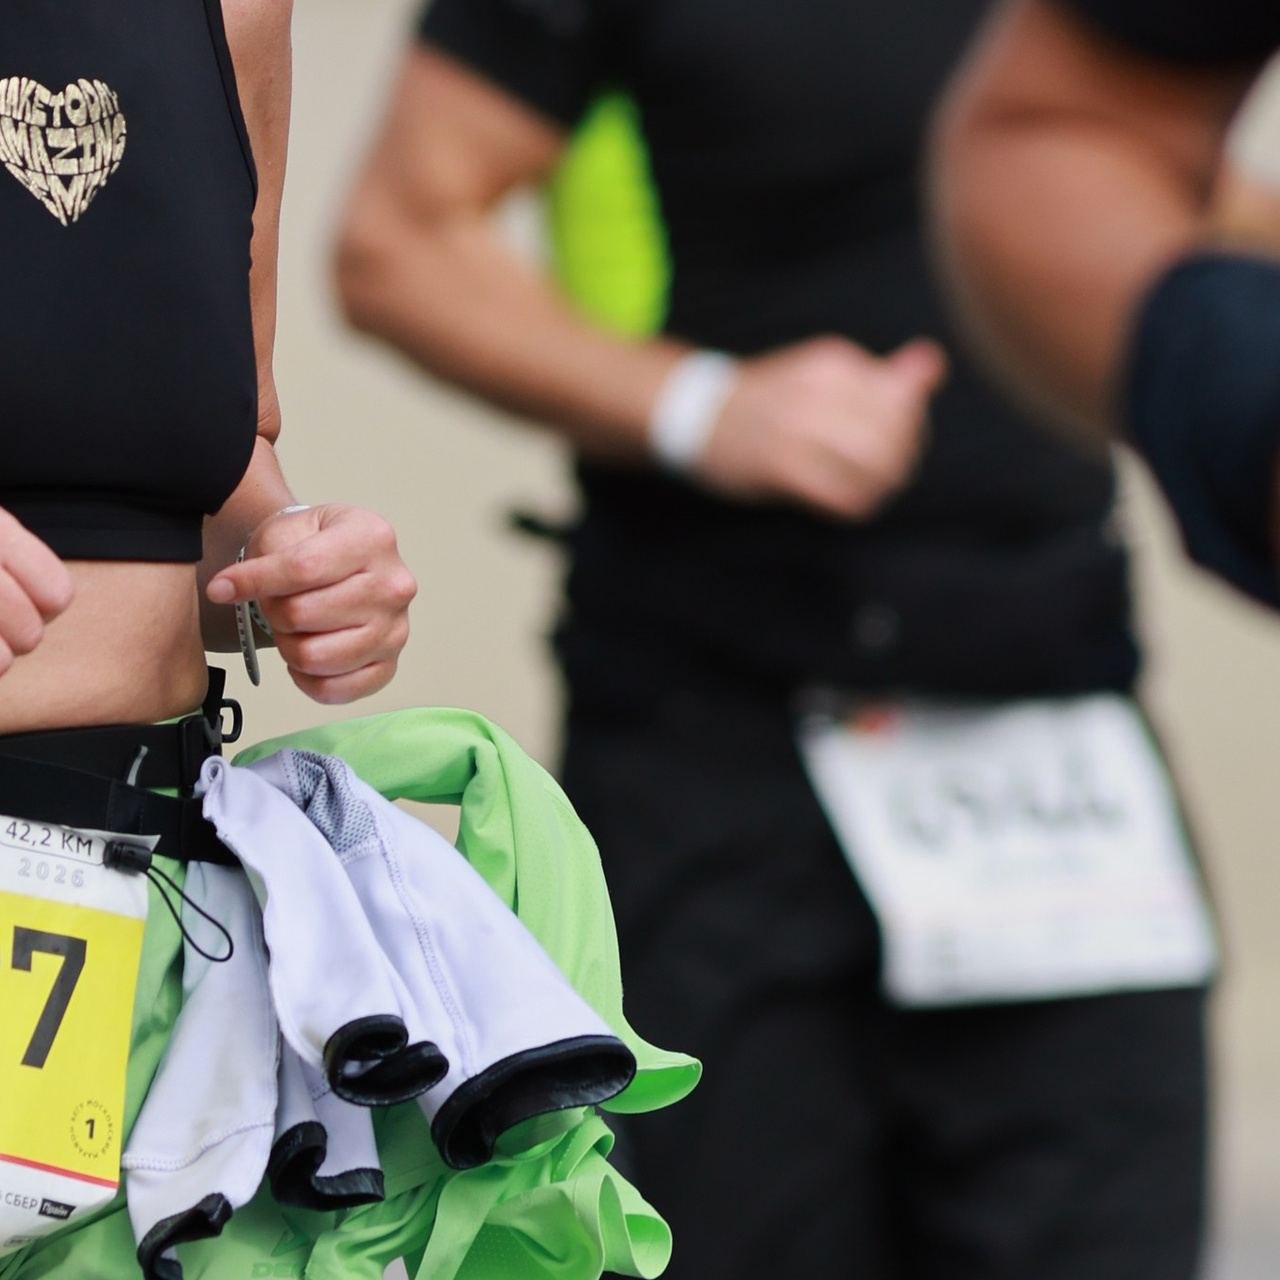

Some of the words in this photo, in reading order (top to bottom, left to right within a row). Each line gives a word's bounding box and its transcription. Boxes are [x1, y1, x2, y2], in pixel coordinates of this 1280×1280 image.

[49, 78, 120, 127] TODAY
[5, 820, 52, 847] 42,2
[18, 858, 85, 888] 2026
[85, 1118, 96, 1140] 1
[4, 1192, 38, 1211] СБЕР
